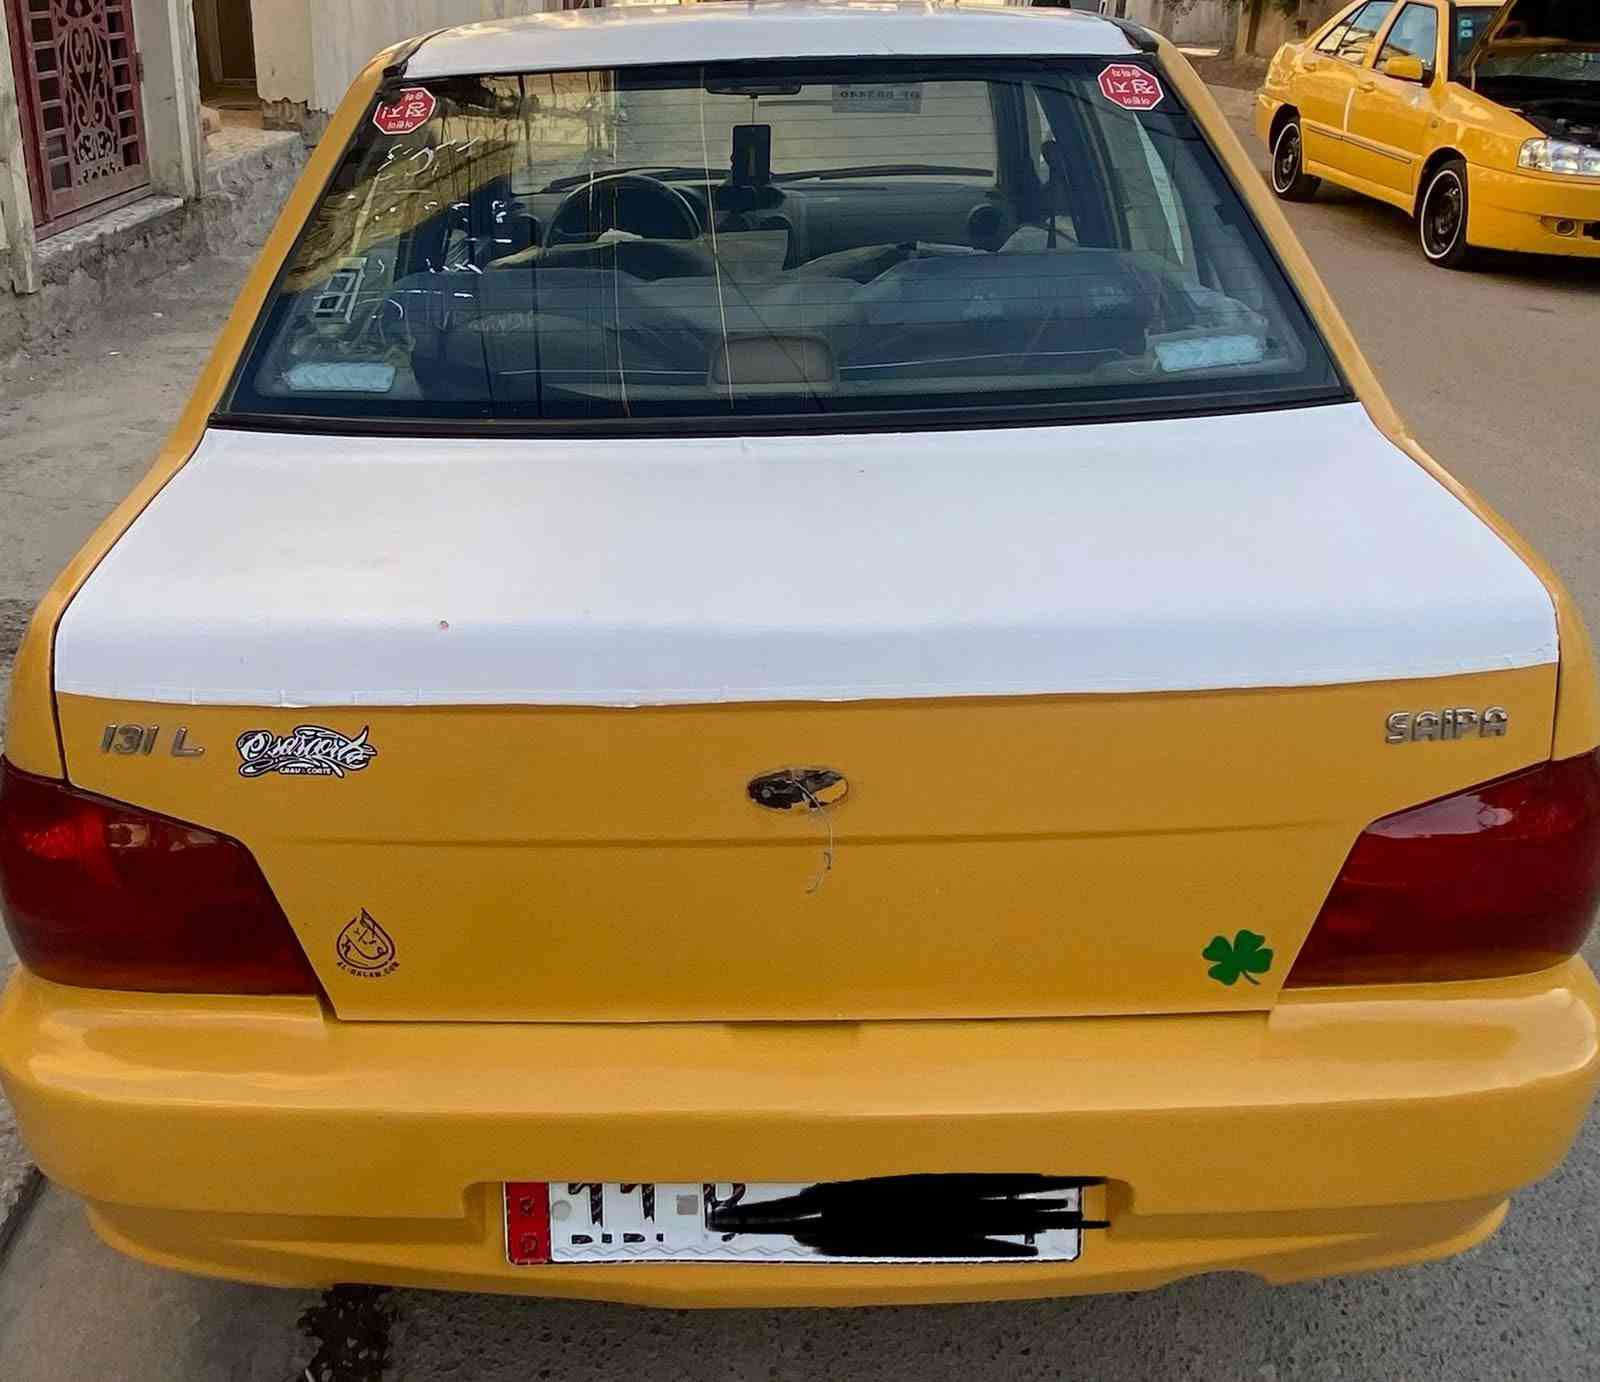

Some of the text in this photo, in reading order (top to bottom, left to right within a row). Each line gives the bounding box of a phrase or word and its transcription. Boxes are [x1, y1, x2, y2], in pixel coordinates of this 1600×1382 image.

[1106, 78, 1155, 95] 정지
[101, 723, 204, 757] 131 L
